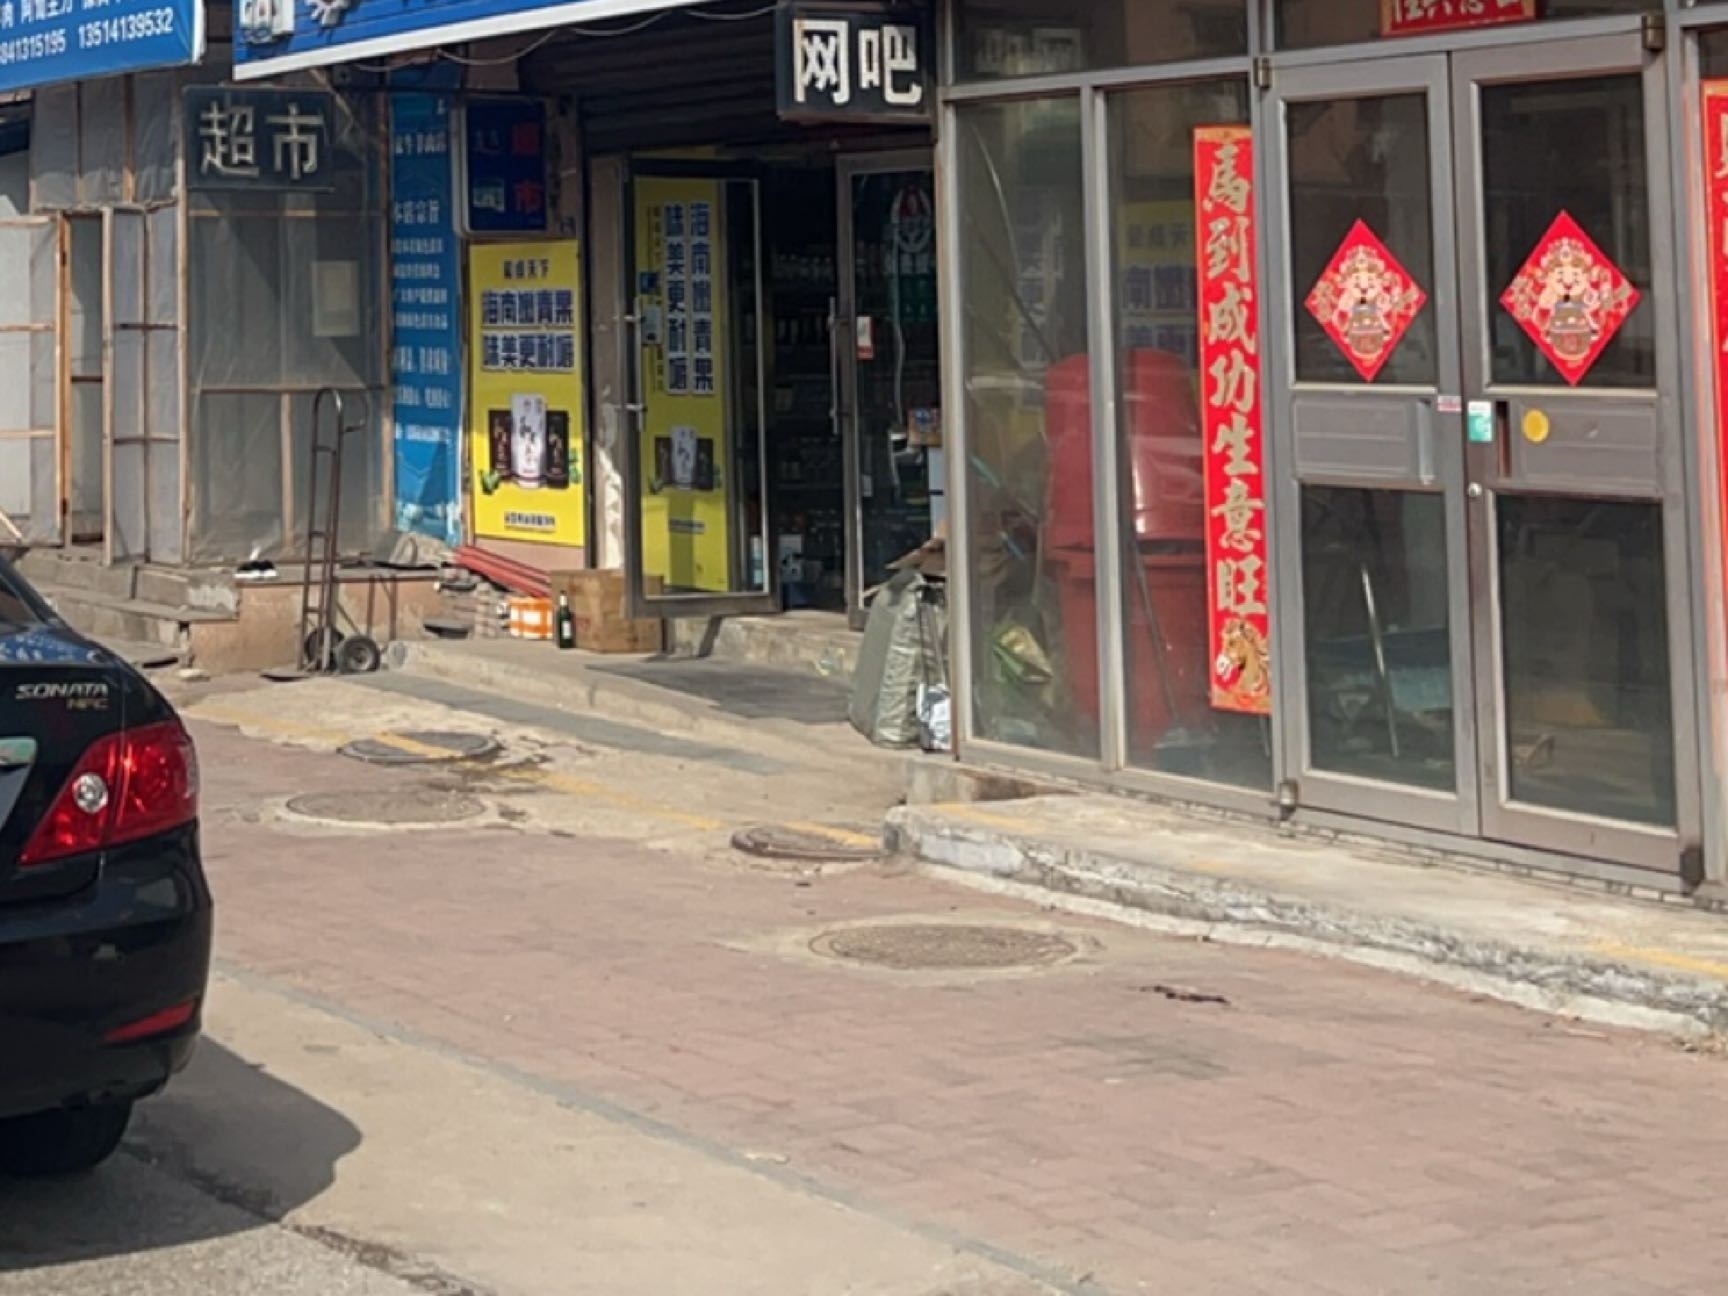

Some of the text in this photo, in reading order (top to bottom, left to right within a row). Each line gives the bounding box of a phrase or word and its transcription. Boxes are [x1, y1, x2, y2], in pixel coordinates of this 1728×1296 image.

[78, 7, 174, 49] 13514139532
[793, 17, 923, 106] 网吧
[199, 102, 325, 180] 超市
[1202, 142, 1269, 618] 馬到成功生意旺
[16, 683, 109, 699] SONATA
